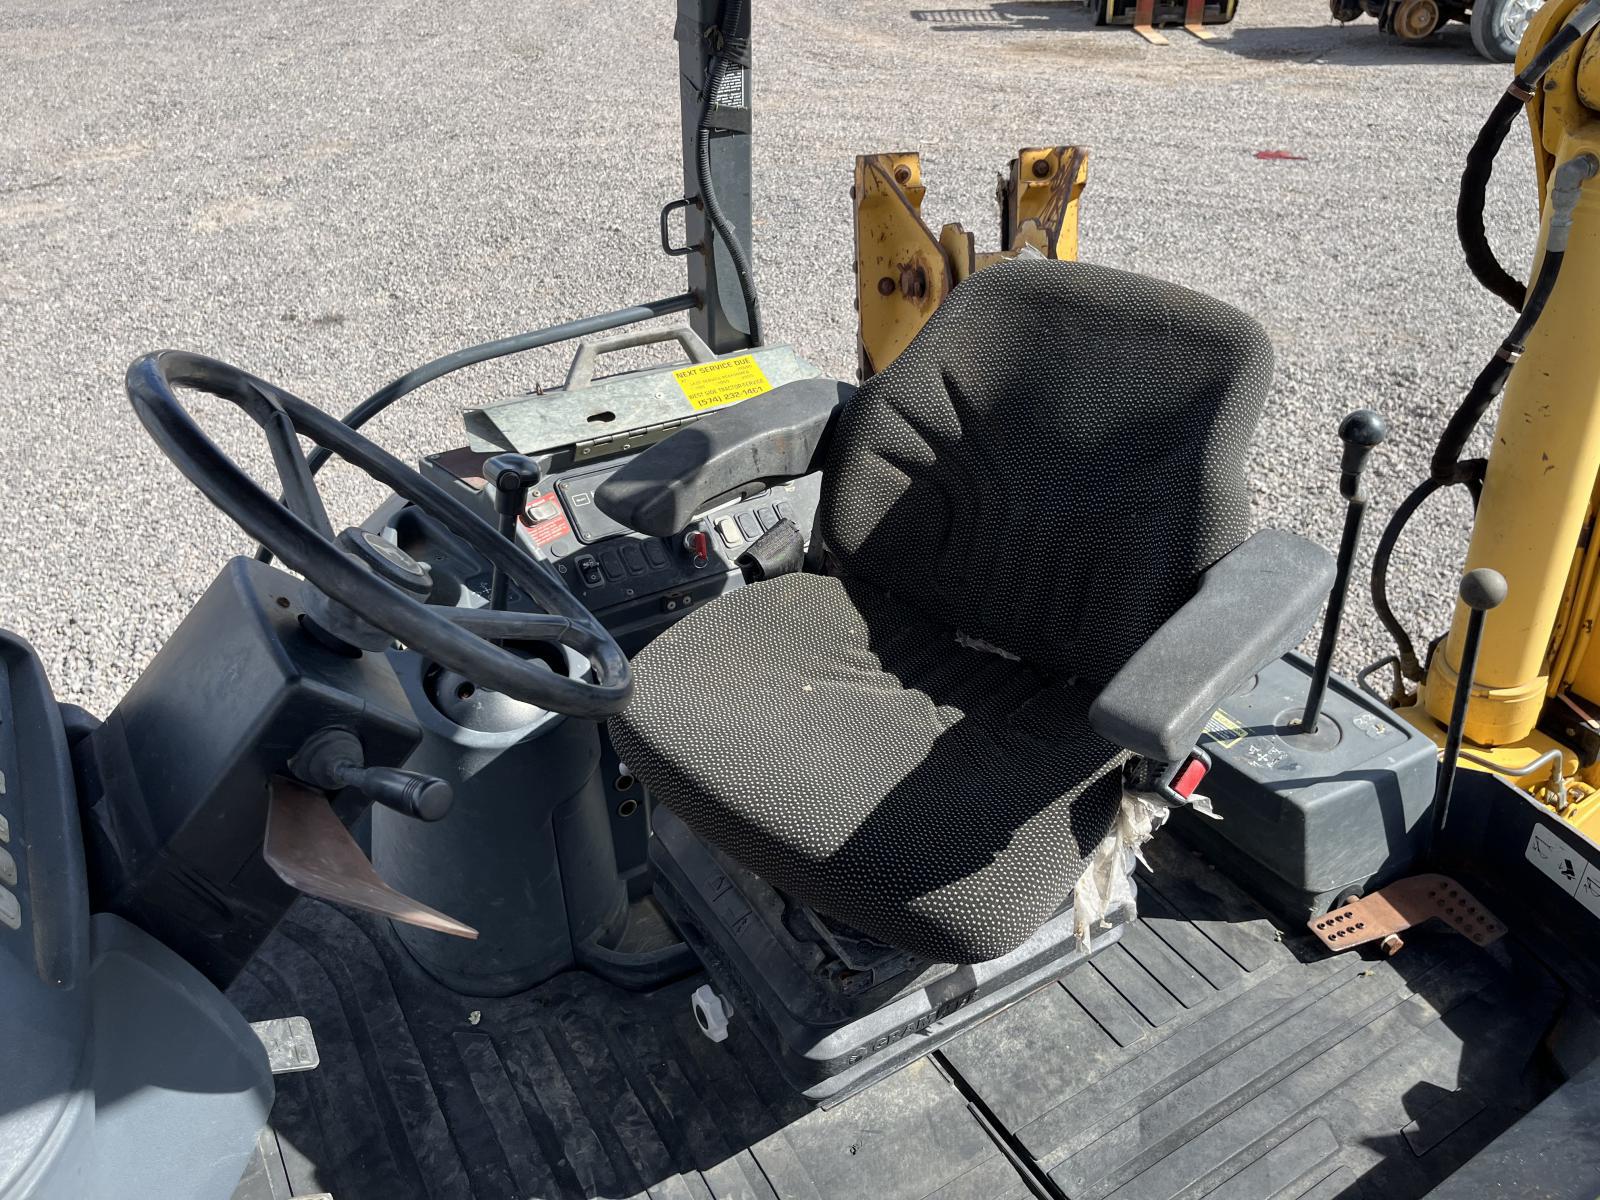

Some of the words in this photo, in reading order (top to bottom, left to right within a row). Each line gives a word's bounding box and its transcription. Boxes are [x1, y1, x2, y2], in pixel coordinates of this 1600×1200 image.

[676, 369, 697, 379] NEXT
[699, 361, 733, 374] SERVICE
[734, 357, 751, 366] DUE
[698, 396, 722, 407] (574)
